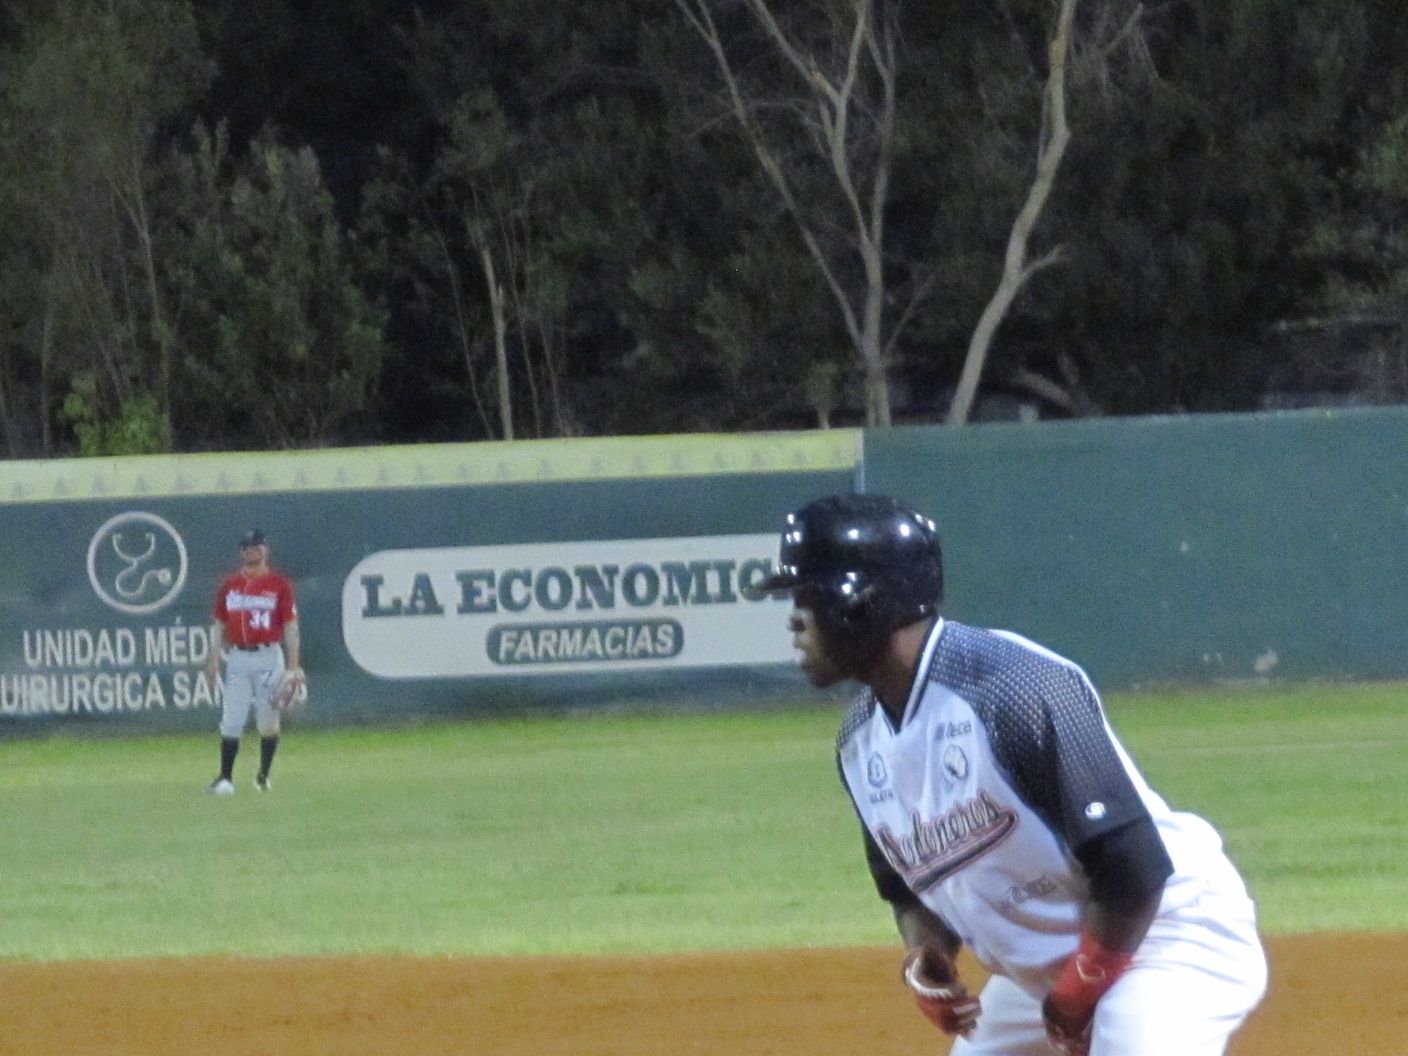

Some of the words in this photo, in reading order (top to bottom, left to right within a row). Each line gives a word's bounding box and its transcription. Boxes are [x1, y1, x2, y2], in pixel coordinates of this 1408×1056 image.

[361, 572, 445, 618] LA
[456, 557, 790, 615] ECONOMIC
[249, 610, 272, 629] 34
[23, 627, 136, 668] UNIDAD
[499, 623, 675, 661] FARMACIAS
